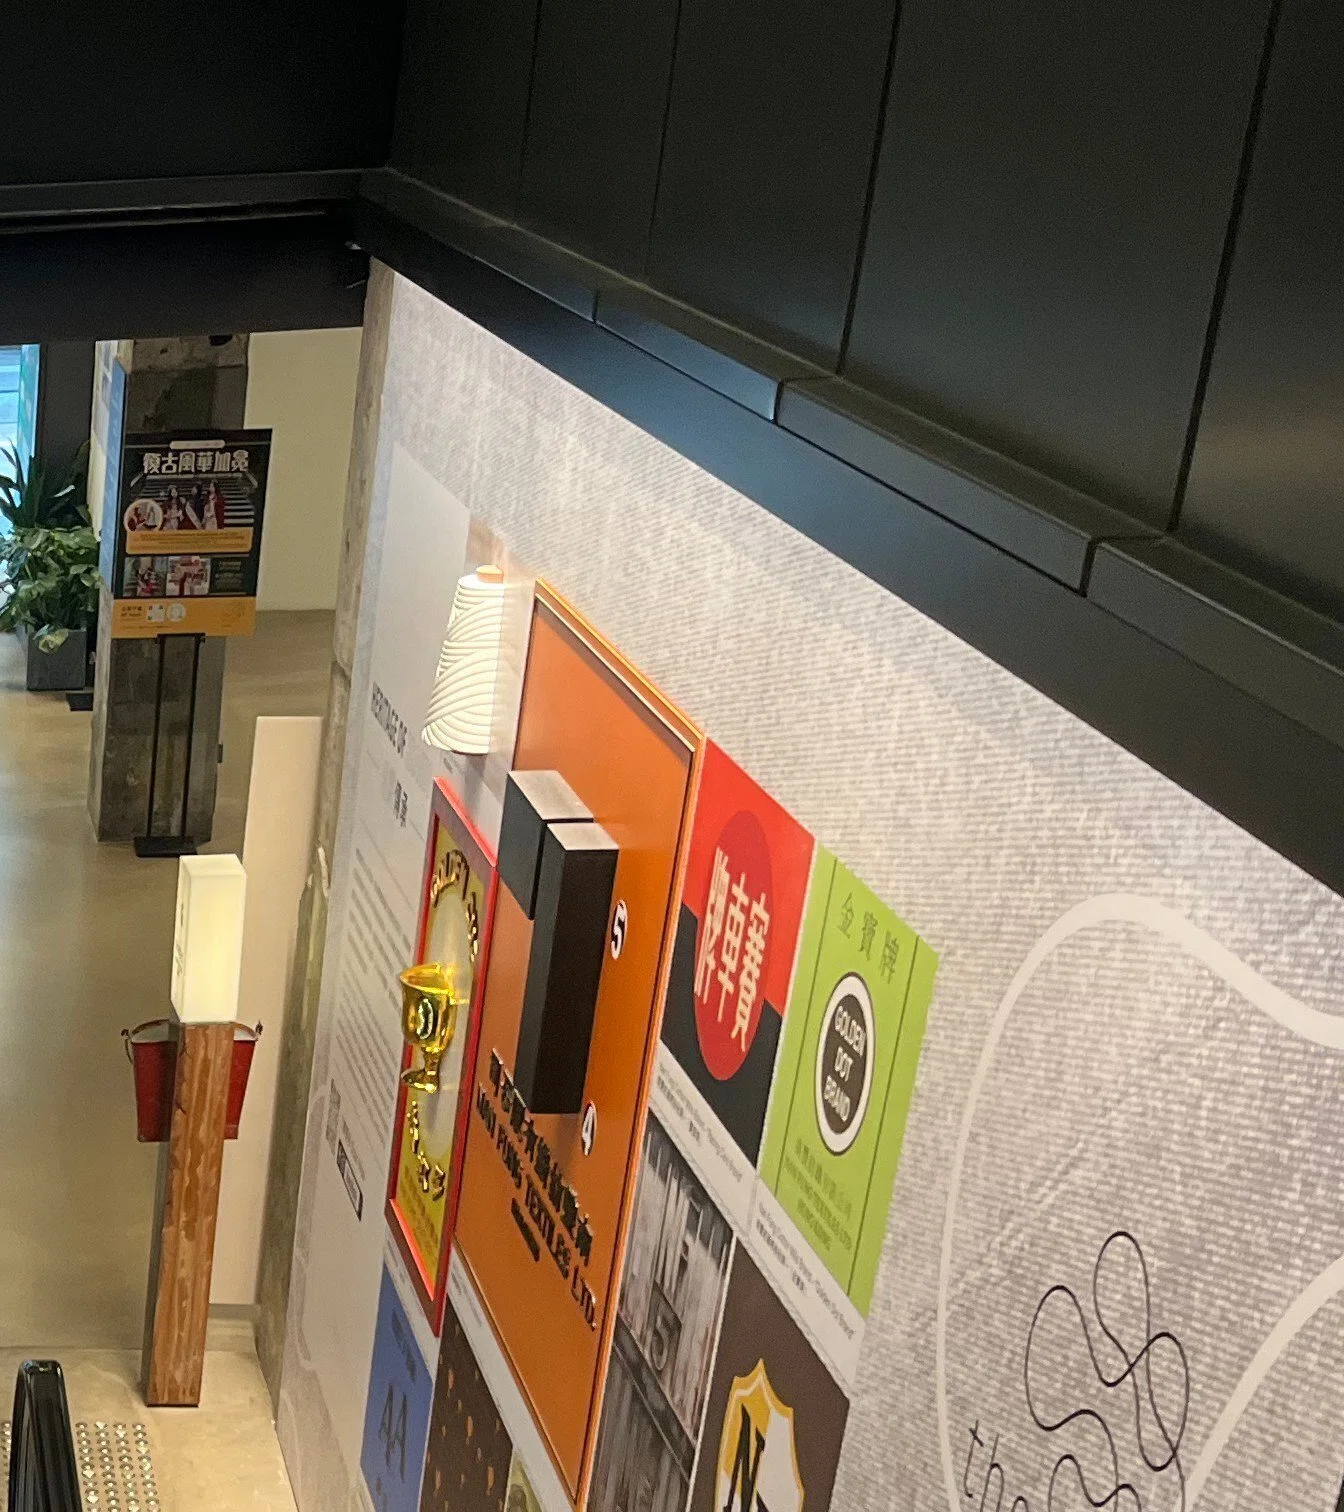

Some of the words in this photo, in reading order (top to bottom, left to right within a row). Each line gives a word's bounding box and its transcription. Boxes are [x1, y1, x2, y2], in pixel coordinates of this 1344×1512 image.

[833, 1005, 865, 1056] GOLDEN
[834, 1046, 854, 1082] DOT
[823, 1074, 851, 1122] BRAND
[582, 1103, 595, 1156] 4
